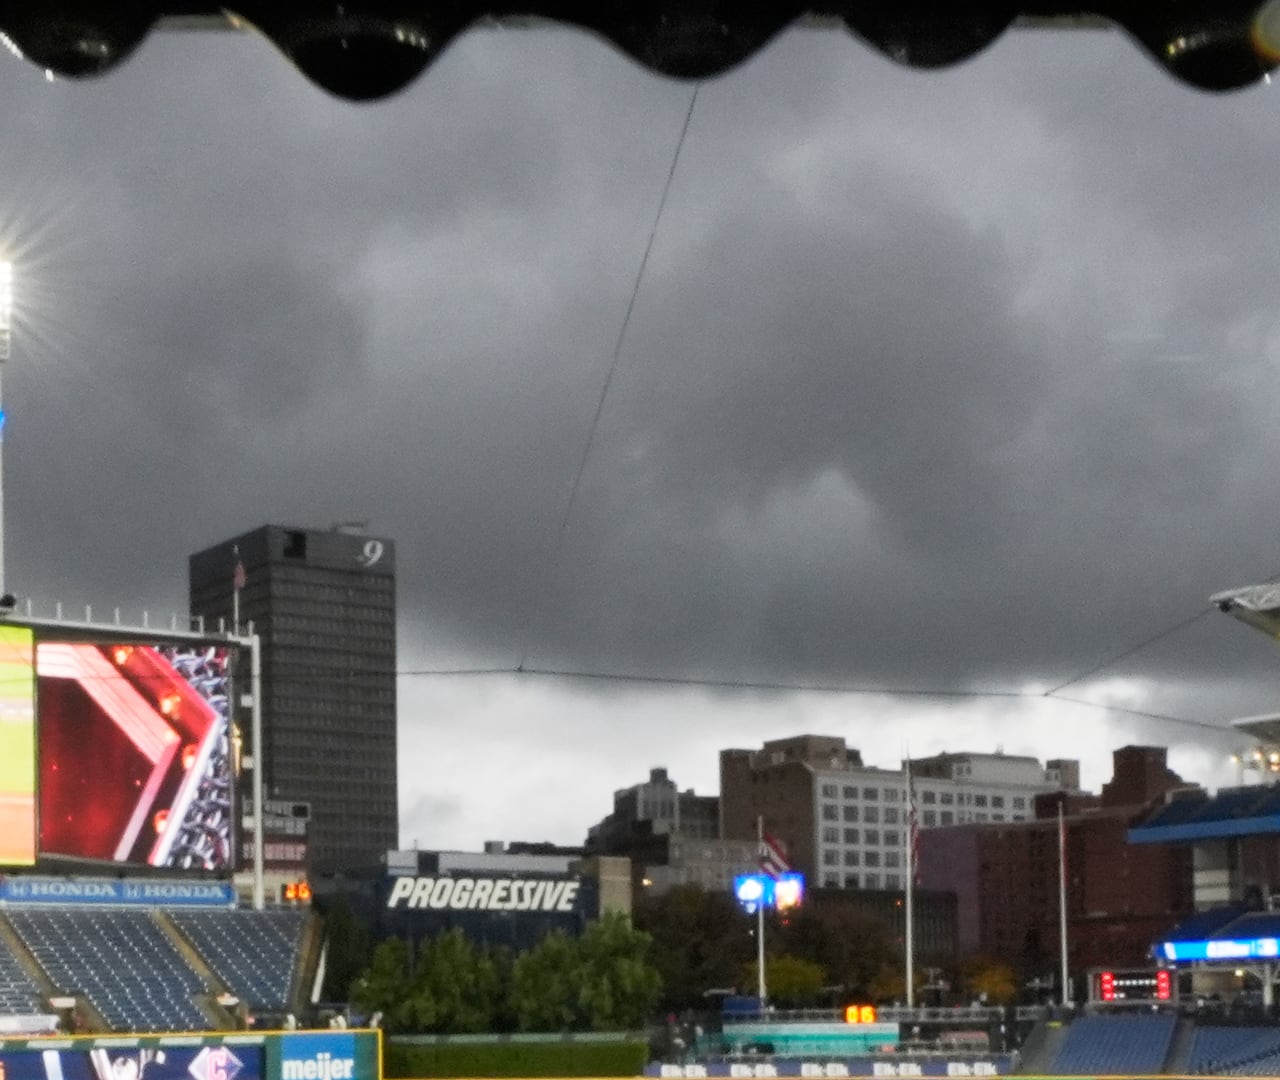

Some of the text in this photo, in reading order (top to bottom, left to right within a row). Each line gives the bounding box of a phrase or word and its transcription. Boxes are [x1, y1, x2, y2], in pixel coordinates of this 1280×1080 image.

[364, 540, 383, 567] 9
[30, 880, 117, 899] HONDA
[143, 882, 223, 900] HONDA
[388, 876, 581, 912] PROGRESSIVE
